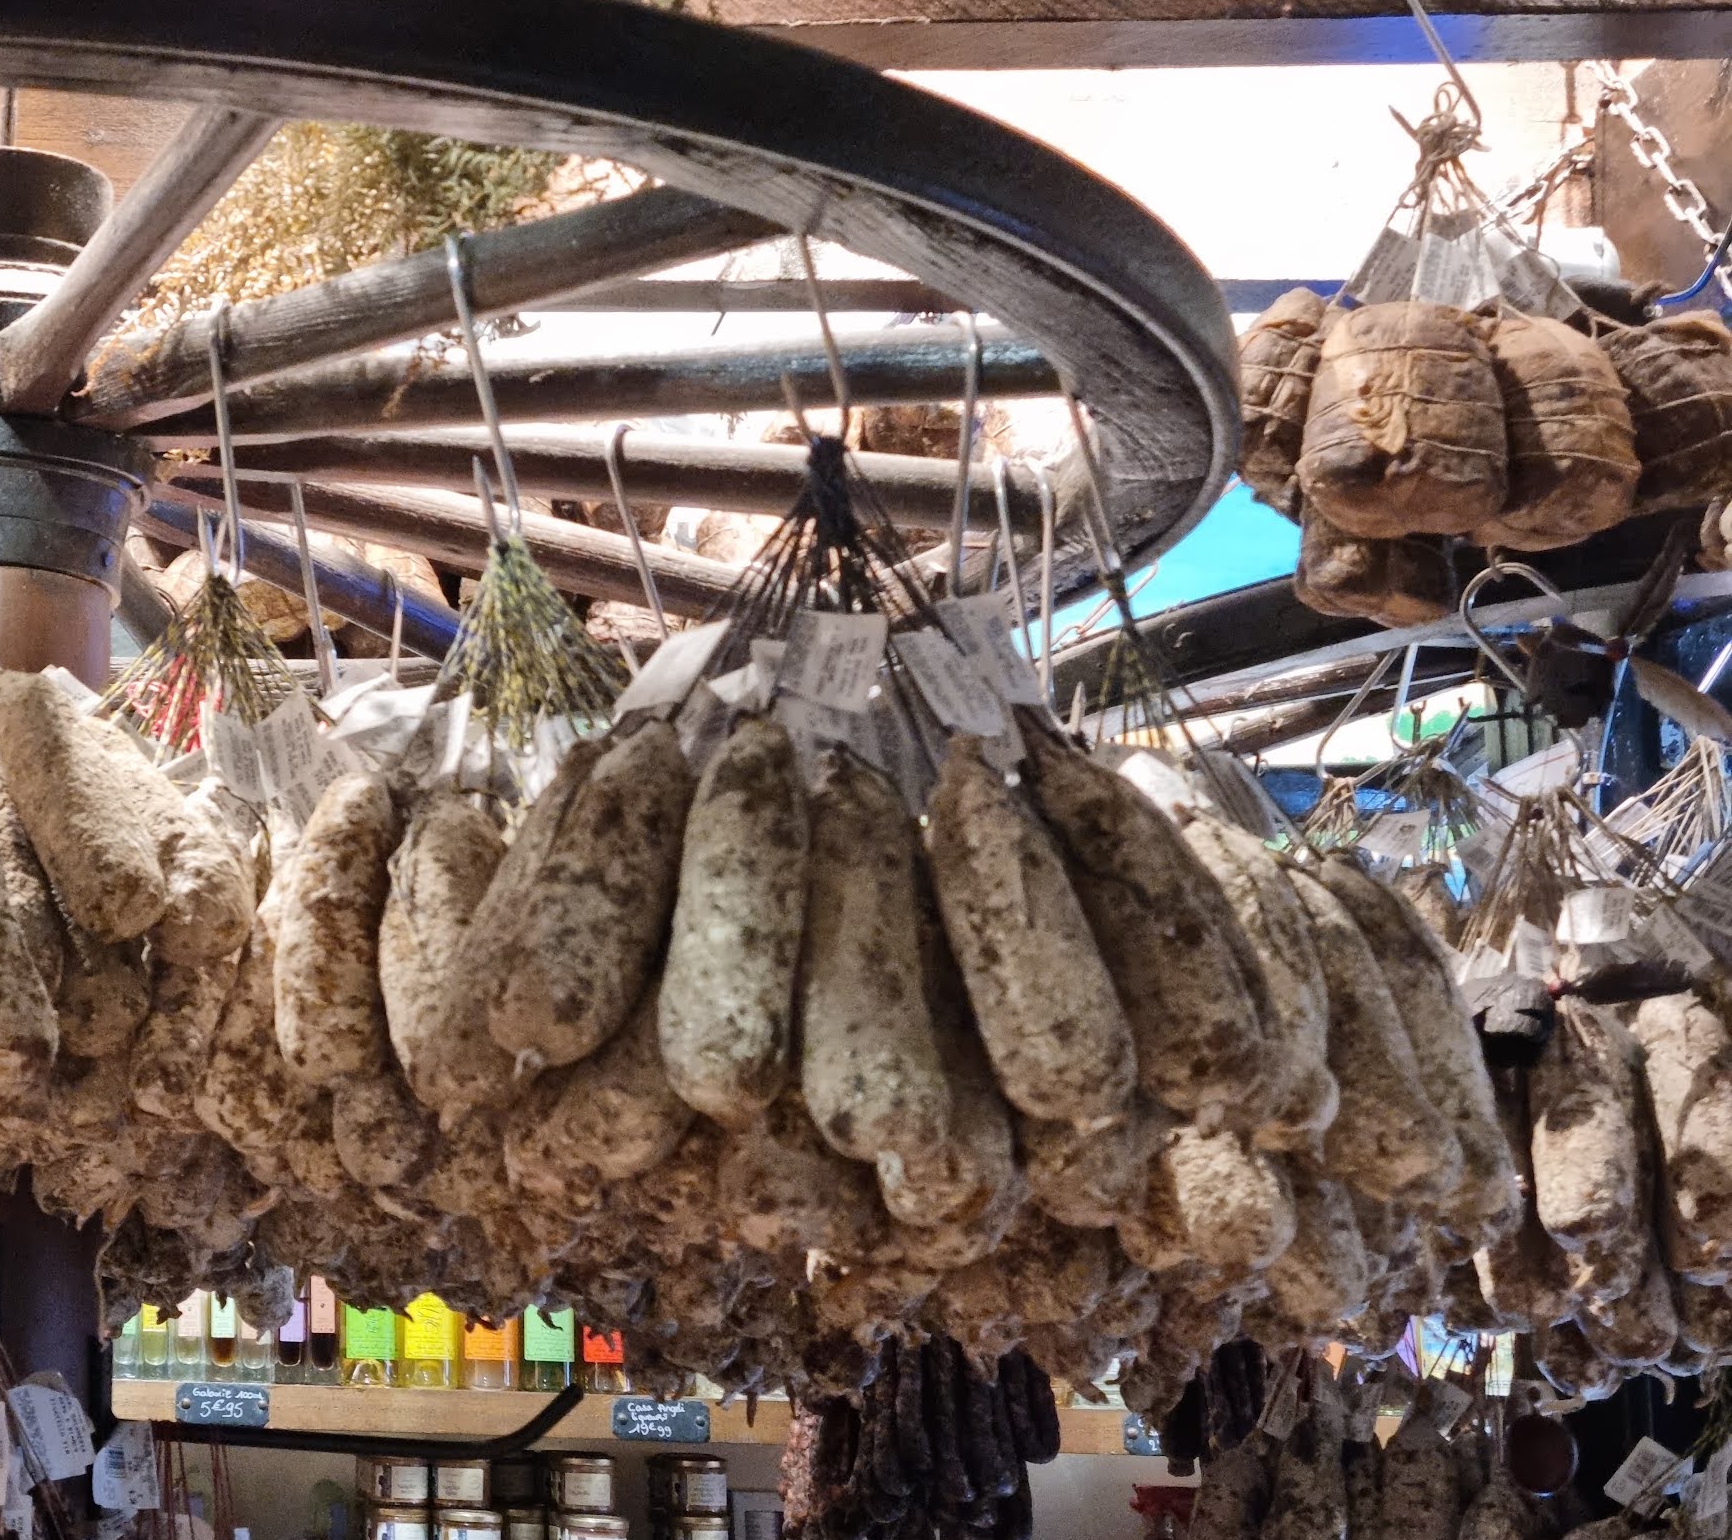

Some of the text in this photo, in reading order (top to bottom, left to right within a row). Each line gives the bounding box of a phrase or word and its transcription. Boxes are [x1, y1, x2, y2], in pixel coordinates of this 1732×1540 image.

[199, 1397, 244, 1419] 5€95
[627, 1401, 686, 1417] Casa Angeli
